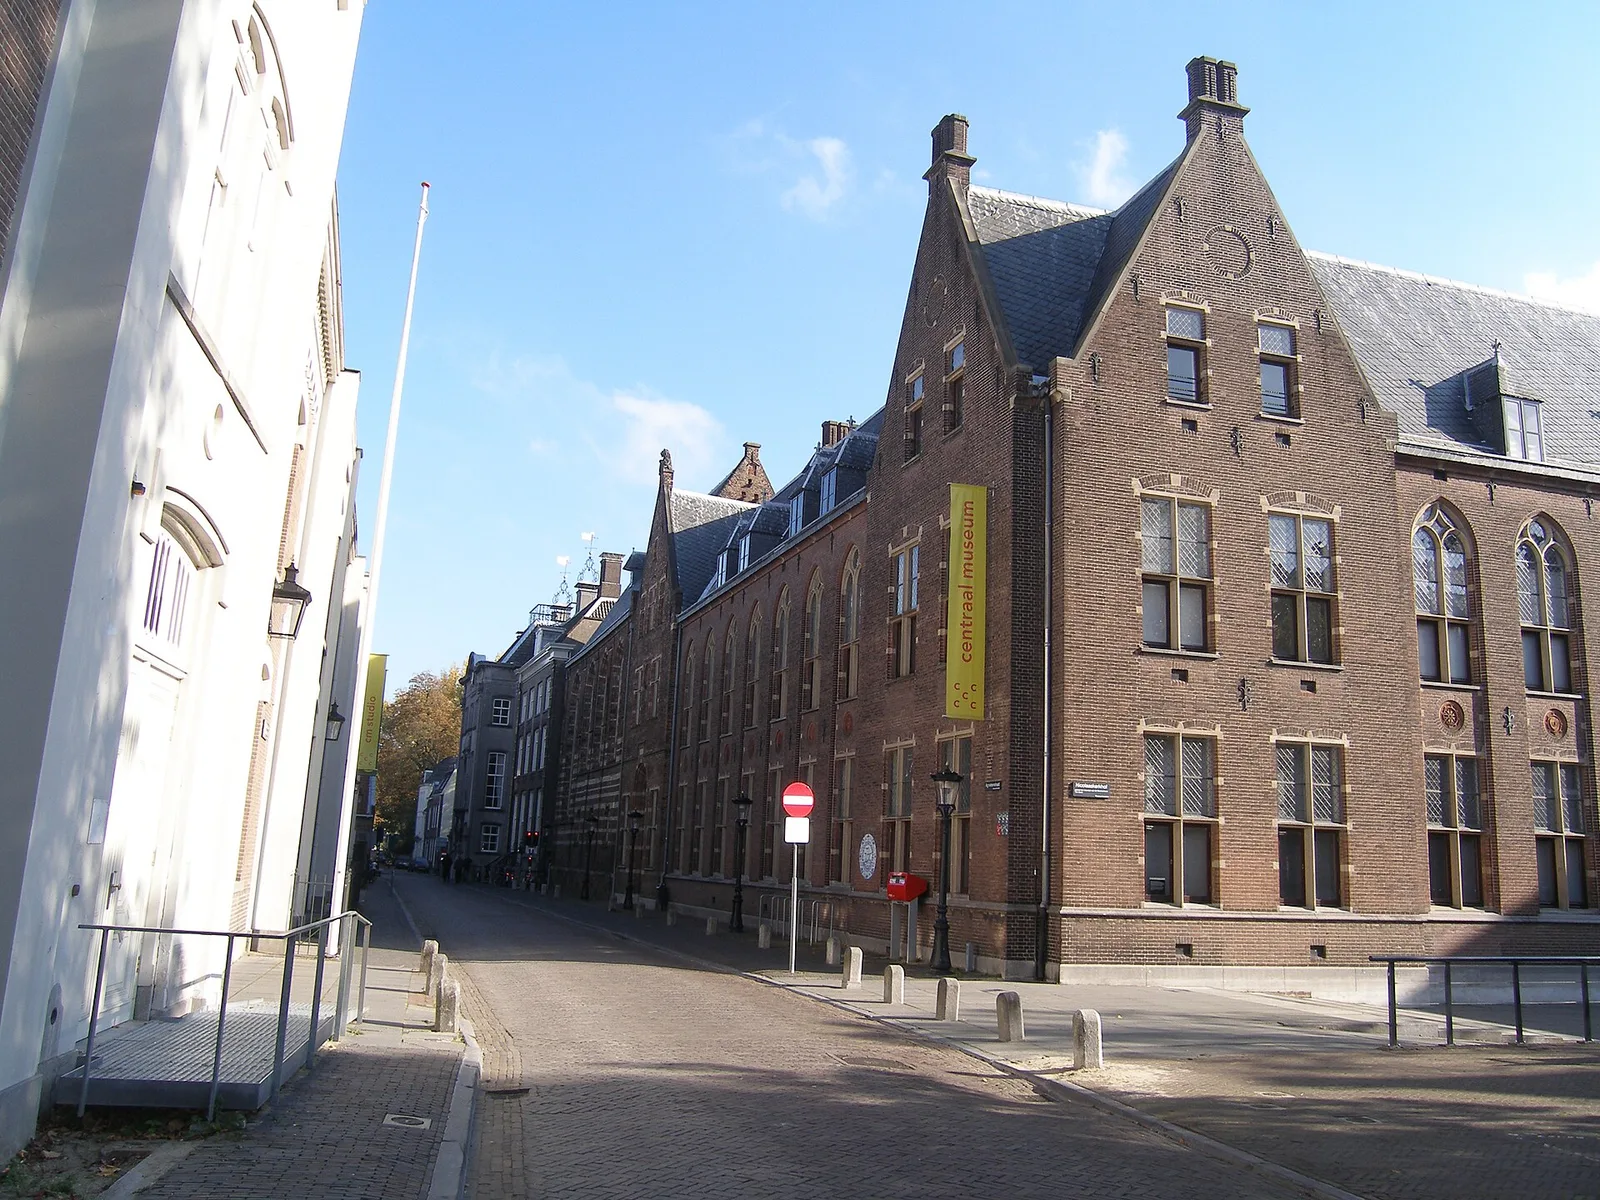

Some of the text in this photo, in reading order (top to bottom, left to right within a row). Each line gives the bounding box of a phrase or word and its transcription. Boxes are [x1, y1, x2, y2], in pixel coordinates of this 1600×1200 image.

[958, 500, 975, 663] centraal museum
[366, 696, 376, 743] cm studio
